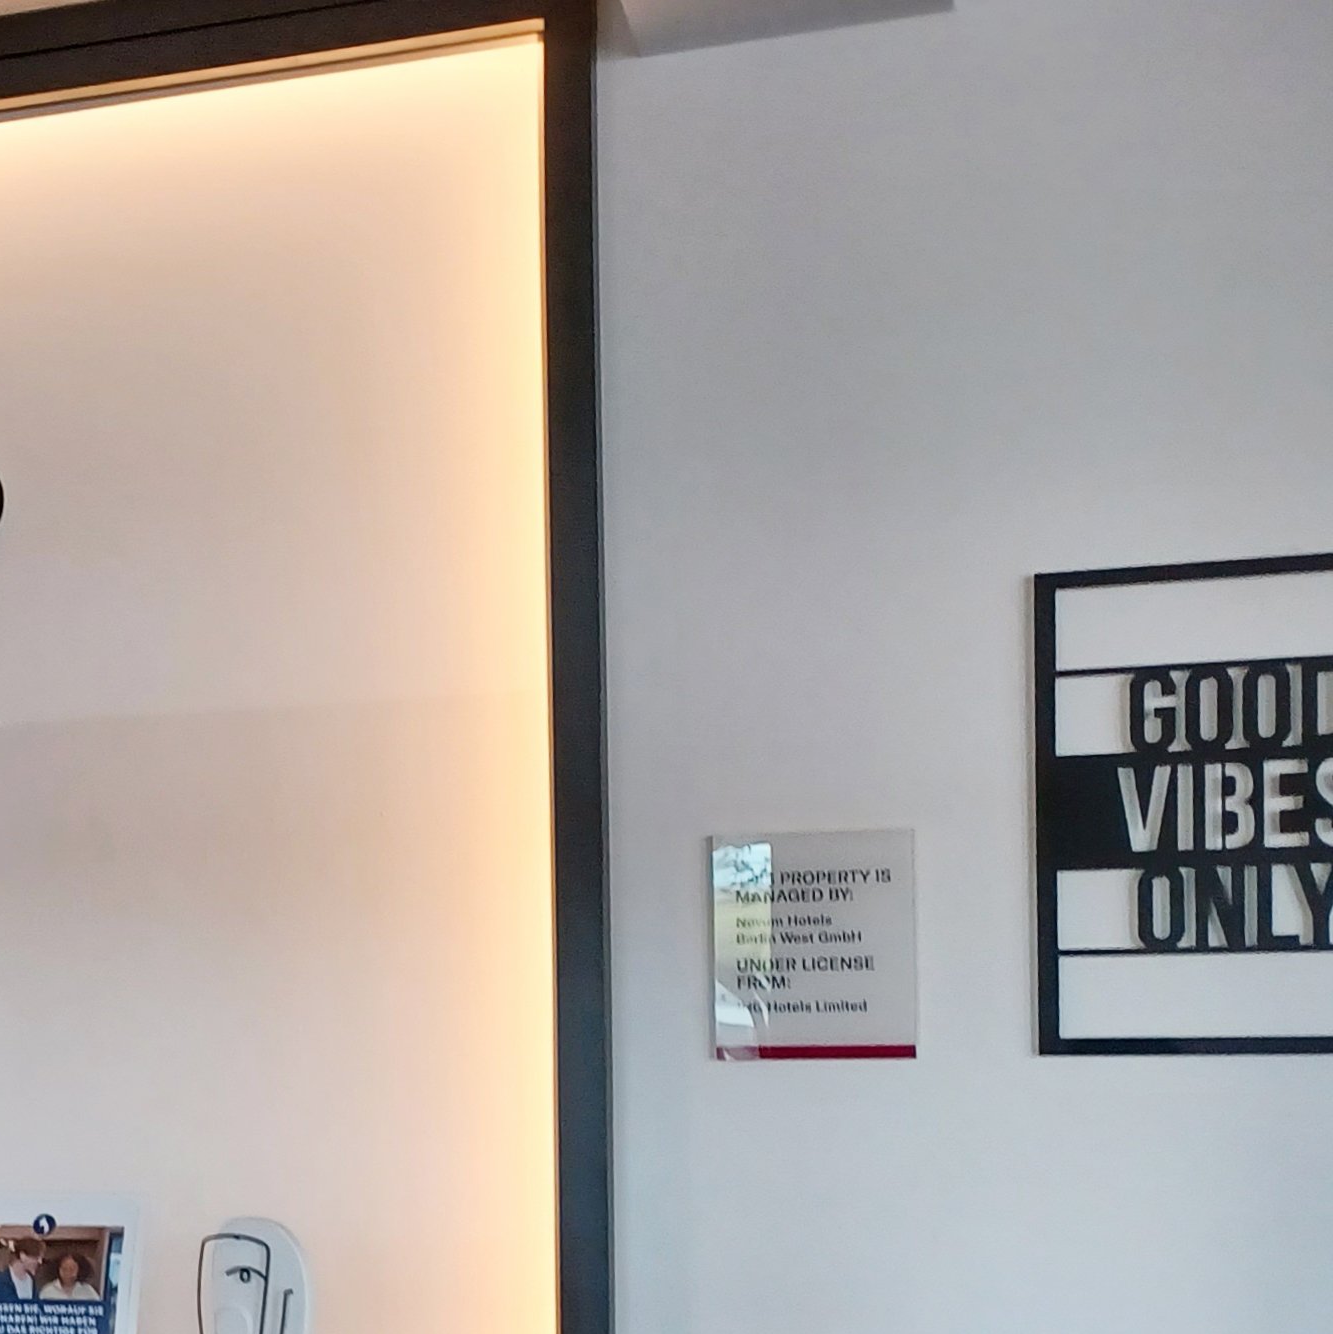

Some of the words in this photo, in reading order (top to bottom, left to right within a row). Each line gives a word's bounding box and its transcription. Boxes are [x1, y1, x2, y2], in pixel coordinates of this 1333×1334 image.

[780, 868, 871, 886] PROPERTY
[875, 867, 892, 884] IS
[736, 887, 824, 904] MANAGED
[787, 913, 833, 928] Hotels
[780, 930, 815, 945] West
[818, 929, 862, 944] GmbH
[736, 956, 797, 974] UNDER
[801, 955, 876, 972] LICENSE
[767, 999, 812, 1014] Hotels
[815, 998, 868, 1013] Limited
